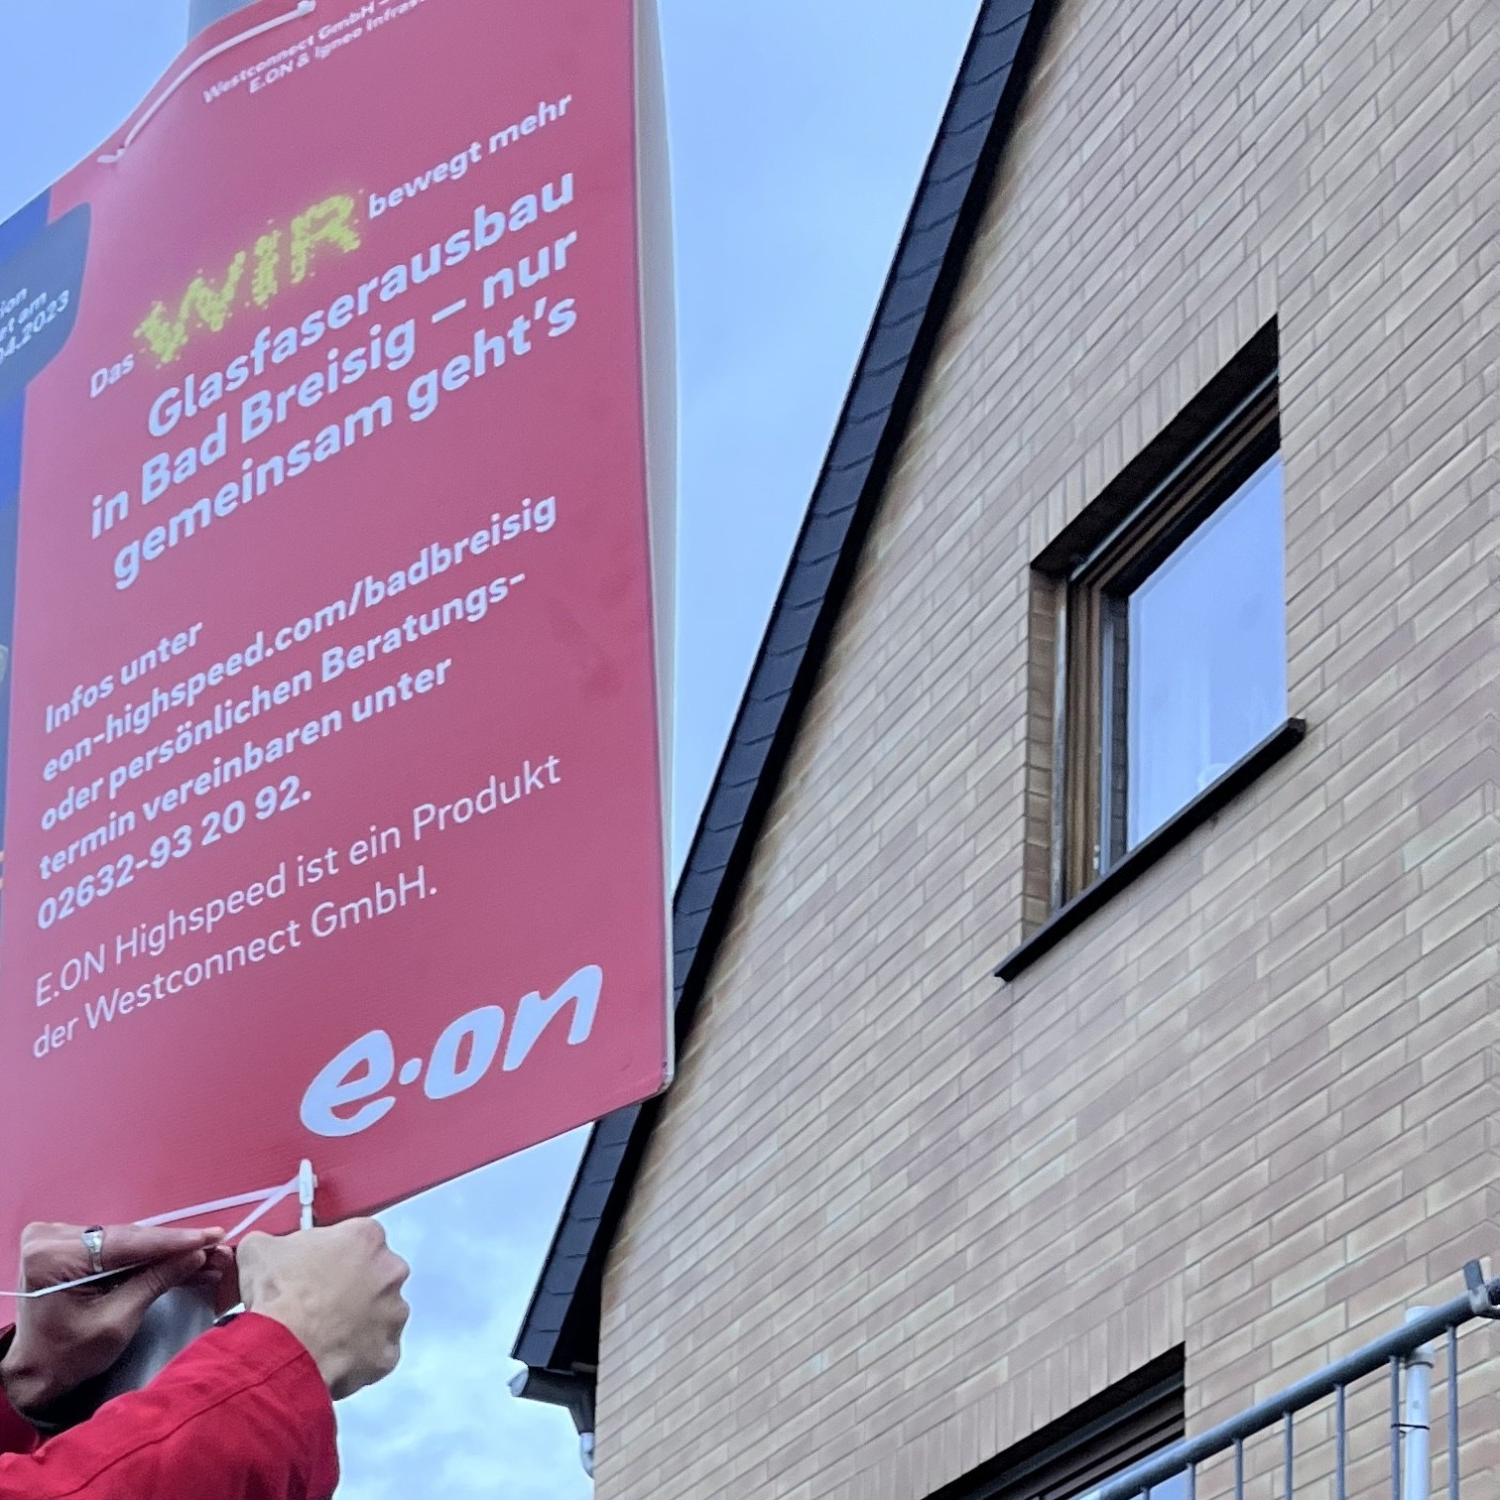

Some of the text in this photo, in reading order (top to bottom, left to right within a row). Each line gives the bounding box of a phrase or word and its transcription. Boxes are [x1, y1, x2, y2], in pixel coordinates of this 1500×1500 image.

[203, 34, 315, 103] Westconnect
[317, 0, 375, 41] GmbH
[249, 0, 425, 94] E.ON & Igneo Infras
[18, 292, 47, 324] am
[90, 353, 134, 398] Das
[368, 141, 482, 220] bewegt
[488, 94, 572, 154] mehr
[148, 172, 574, 437] Glasfaserausbau
[92, 490, 129, 539] in
[141, 412, 227, 505] Bad
[241, 318, 416, 444] Breisig
[482, 230, 578, 309] nur
[114, 395, 393, 590] gemeinsam
[41, 572, 526, 831] oder persönlichen Beratungs-
[43, 495, 557, 781] eon-highspeed.com/badbreisig
[45, 622, 203, 734] Infos unter
[37, 775, 312, 929] 02632-93 20 92.
[39, 658, 452, 880] termin vereinbaren unter
[33, 864, 438, 1058] der Westconnect GmbH.
[36, 755, 562, 1007] E.ON Highspeed ist ein Produkt
